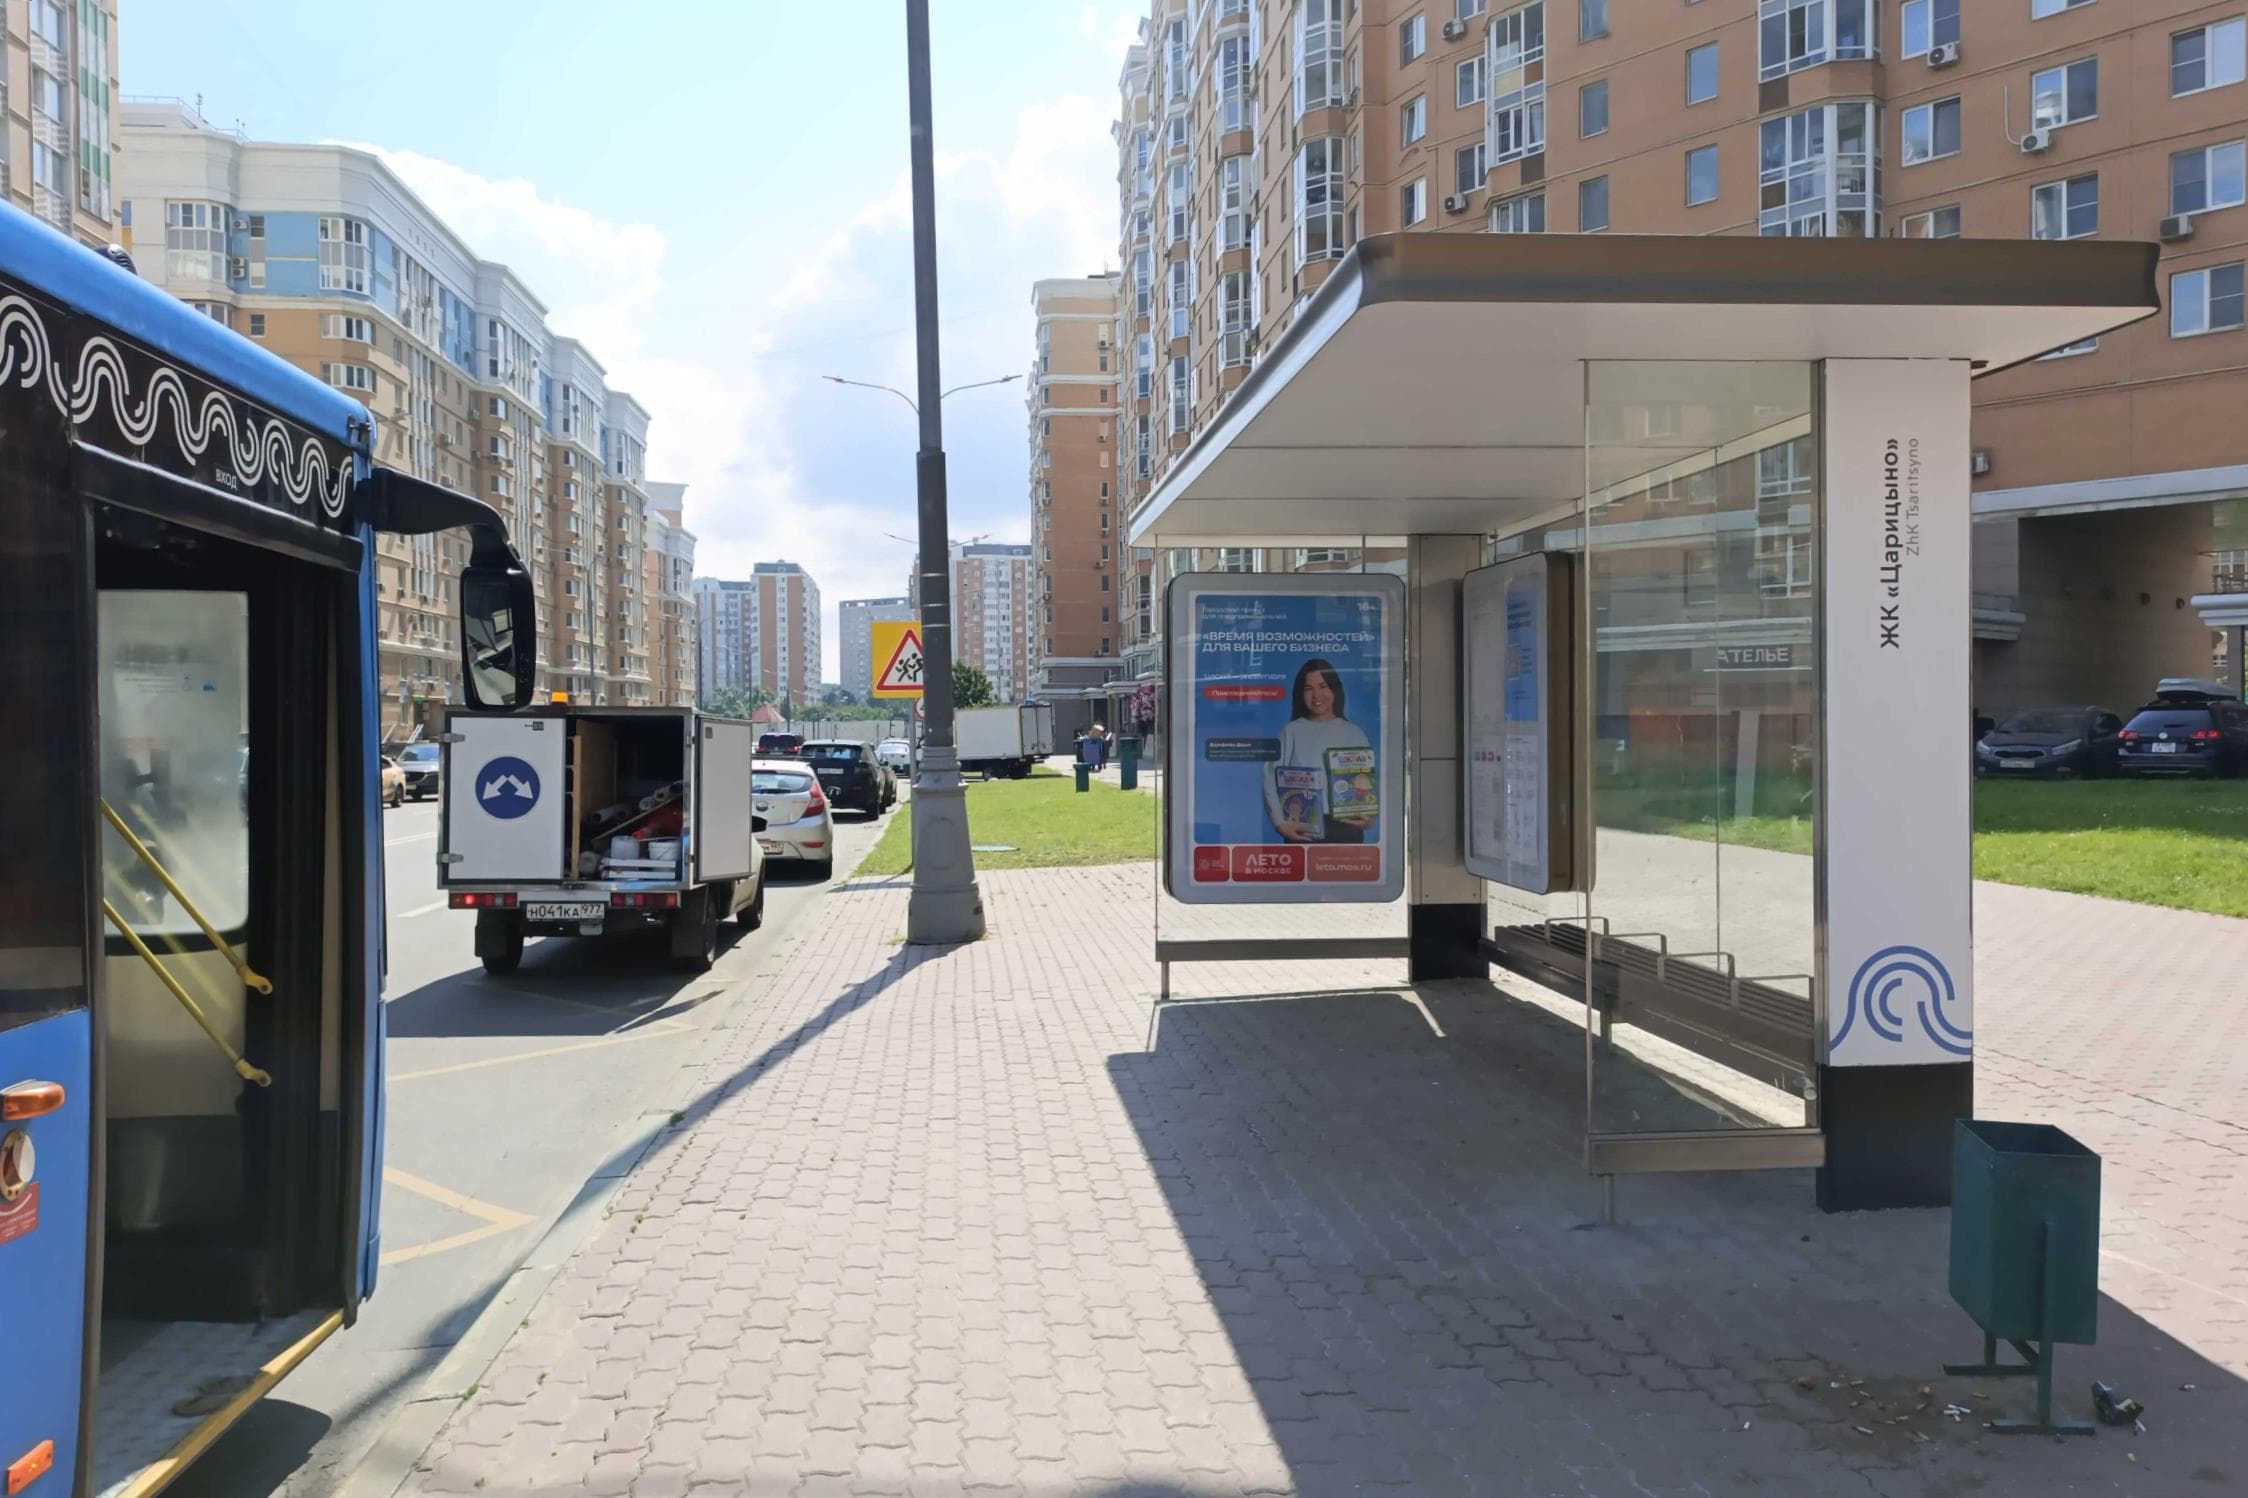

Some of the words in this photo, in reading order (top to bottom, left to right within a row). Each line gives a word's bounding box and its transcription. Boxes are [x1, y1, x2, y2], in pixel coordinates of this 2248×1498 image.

[215, 468, 238, 490] ВХОД
[1906, 438, 1922, 519] Tsaritsyno
[1880, 438, 1903, 598] «Царицыно»
[1906, 523, 1920, 556] ZhK
[1202, 631, 1254, 641] «ВРЕМЯ
[1256, 630, 1376, 642] ВОЗМОЖНОСТЕЙ»
[1880, 604, 1900, 649] ЖК
[1202, 643, 1232, 653] ДЛЯ
[1233, 643, 1288, 652] ВАШЕГО
[1289, 643, 1350, 652] БИЗНЕСА
